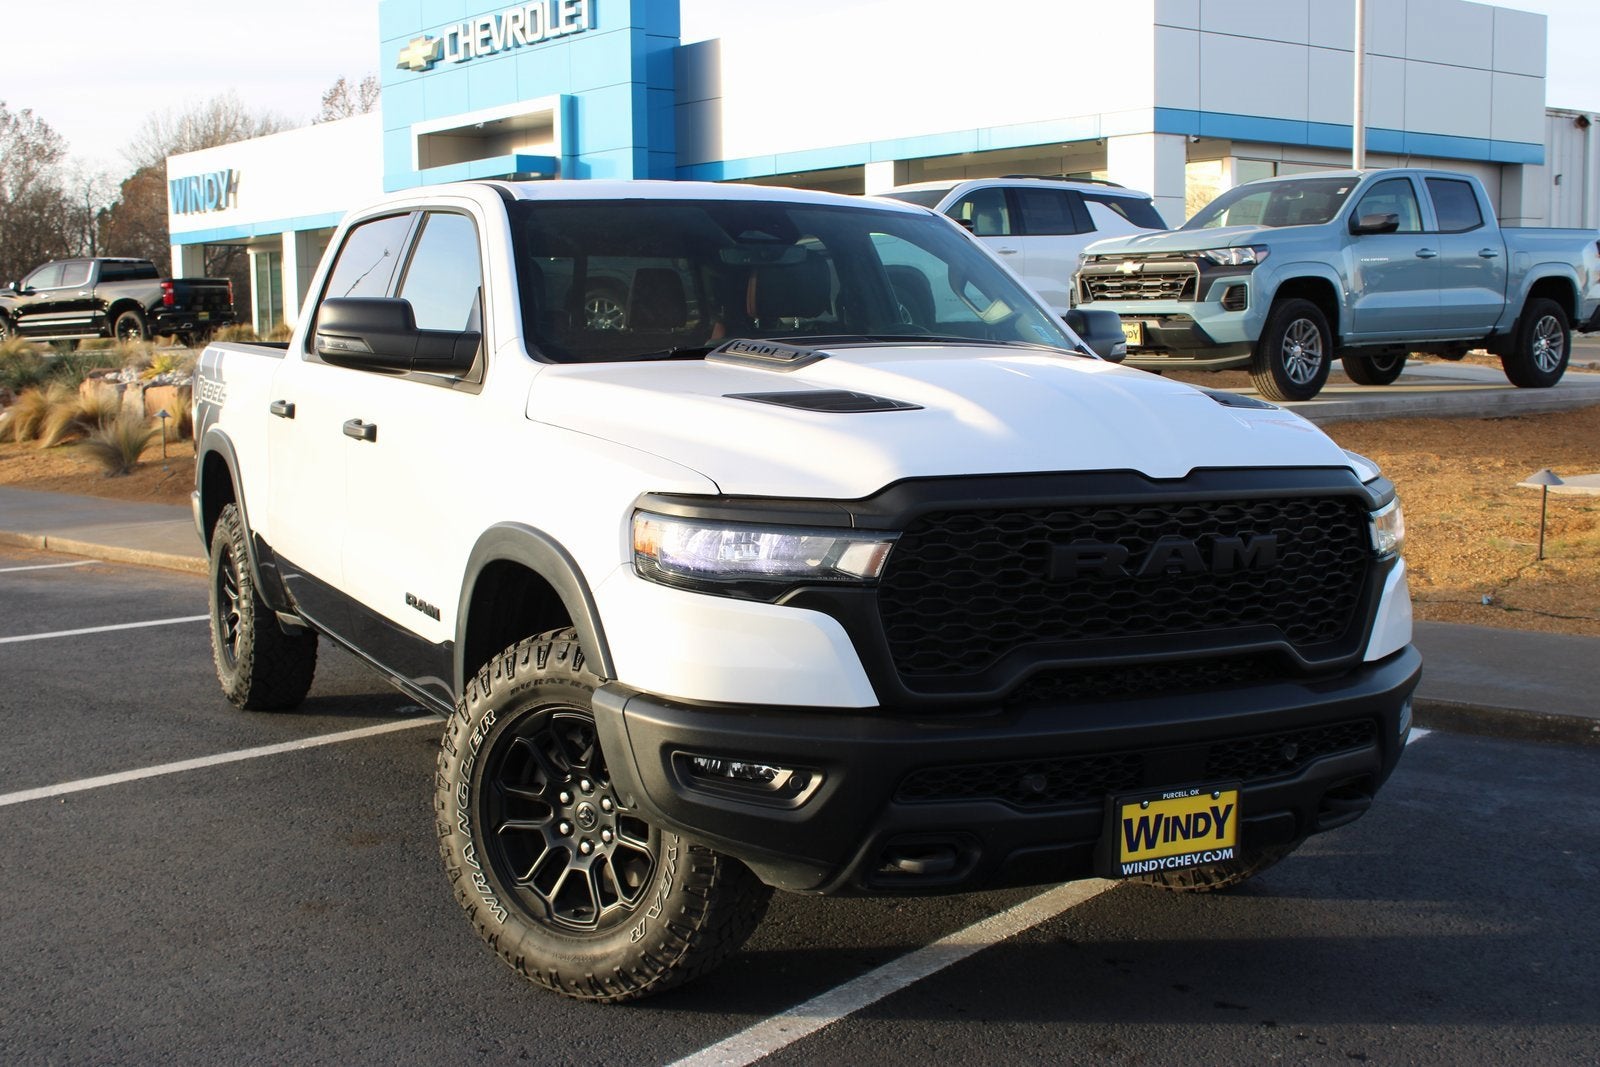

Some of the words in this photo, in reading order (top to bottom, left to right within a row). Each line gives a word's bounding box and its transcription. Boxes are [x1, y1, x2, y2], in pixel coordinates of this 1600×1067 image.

[443, 0, 591, 63] CHEVROLET
[169, 168, 233, 215] WINDY
[1050, 533, 1278, 580] RAM
[405, 591, 441, 622] RAM
[510, 677, 595, 696] DURATRA
[1189, 788, 1200, 797] OK
[456, 708, 510, 925] WRANGLER
[1123, 803, 1235, 853] WINDY
[1122, 848, 1234, 876] WINDYCHEV.COM
